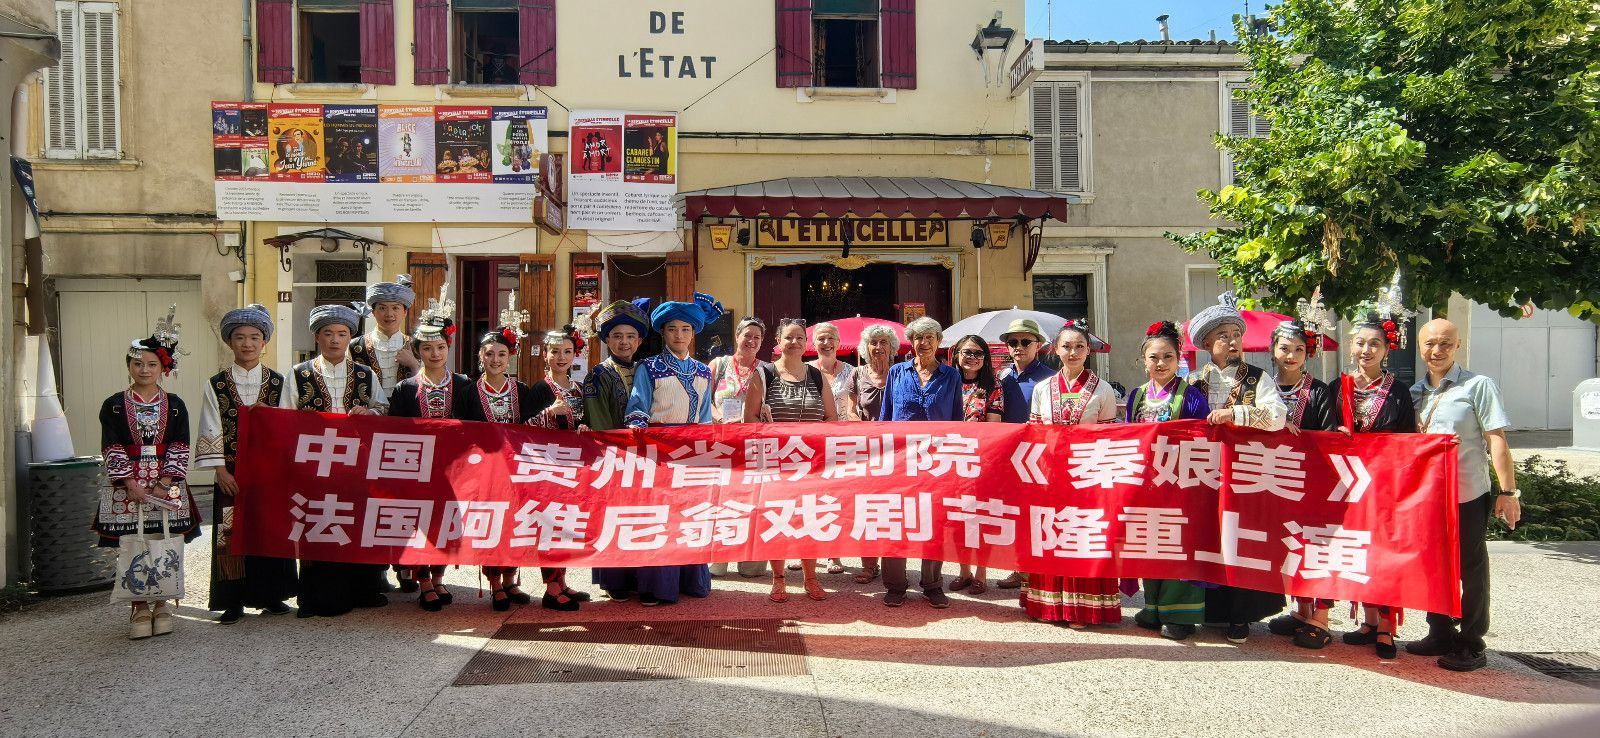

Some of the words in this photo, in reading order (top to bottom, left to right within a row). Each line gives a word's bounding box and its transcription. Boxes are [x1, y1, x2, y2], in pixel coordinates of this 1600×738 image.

[649, 10, 684, 34] DE
[280, 292, 290, 302] 14
[287, 492, 1372, 584] 法国阿维尼翁戏剧节隆重上演
